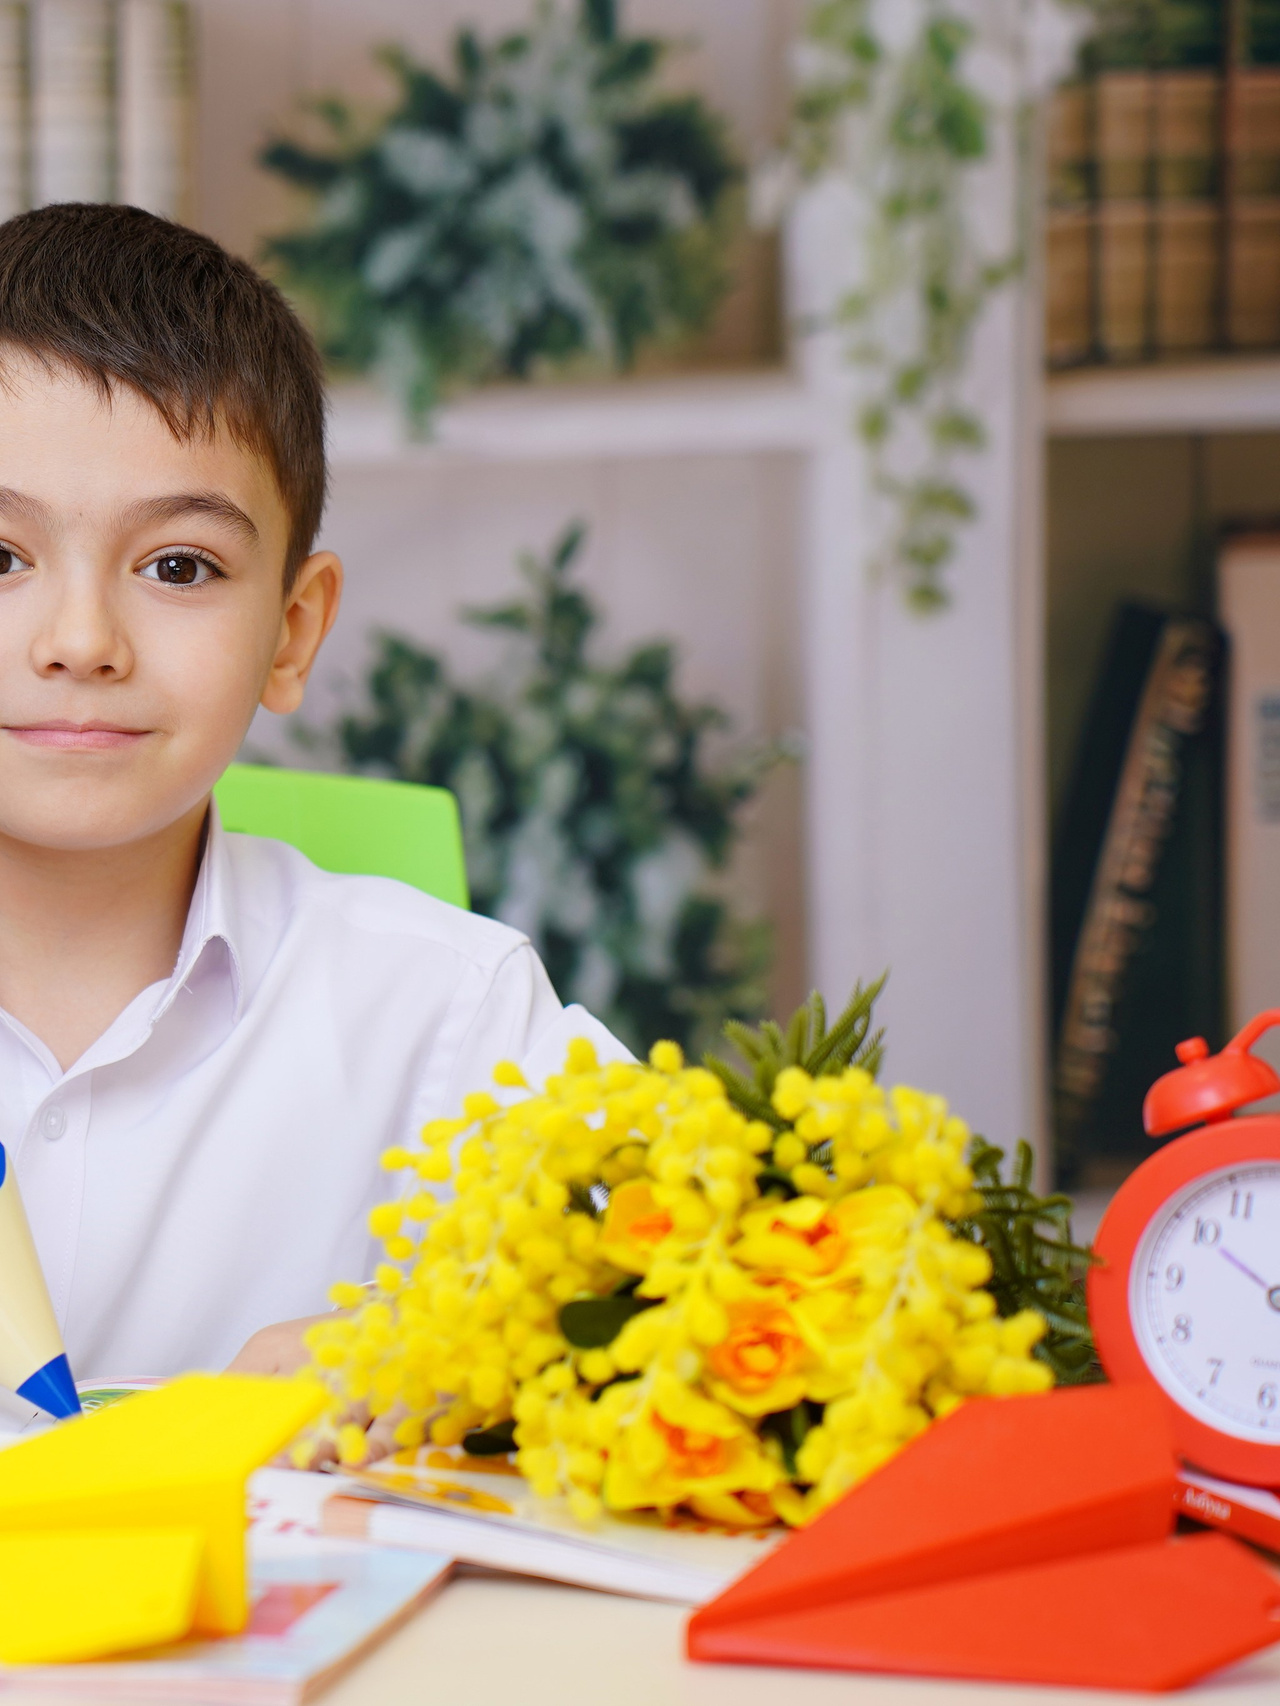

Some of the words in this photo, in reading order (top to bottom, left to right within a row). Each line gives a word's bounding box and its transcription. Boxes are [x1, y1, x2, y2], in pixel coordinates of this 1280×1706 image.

[1229, 1187, 1254, 1220] 11
[1192, 1215, 1221, 1246] 10
[1165, 1262, 1185, 1292] 9
[1171, 1312, 1192, 1343] 8
[1206, 1356, 1225, 1386] 7
[1257, 1380, 1278, 1412] 6
